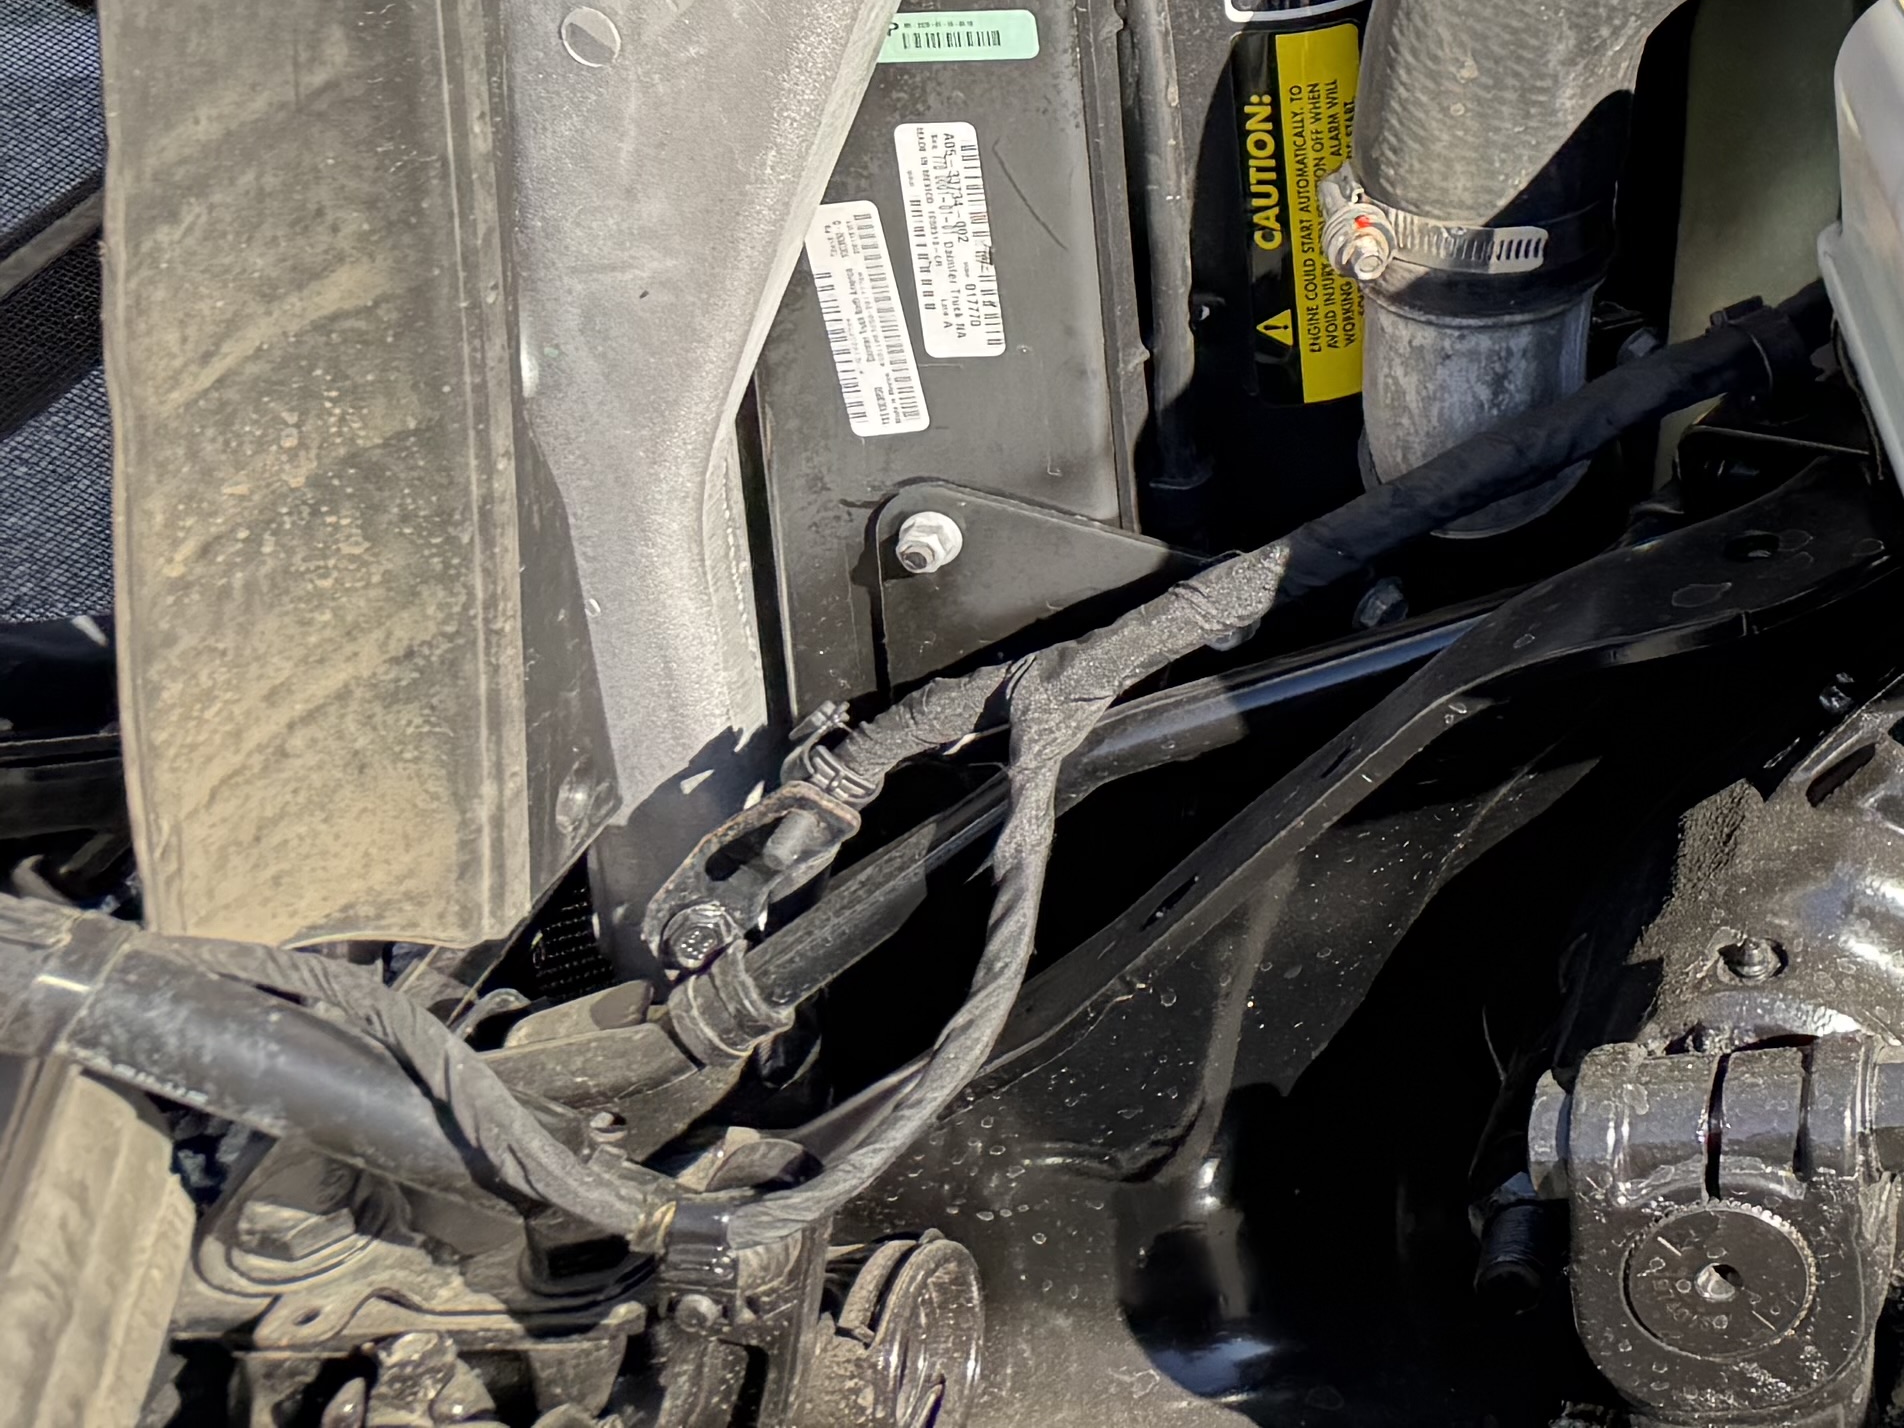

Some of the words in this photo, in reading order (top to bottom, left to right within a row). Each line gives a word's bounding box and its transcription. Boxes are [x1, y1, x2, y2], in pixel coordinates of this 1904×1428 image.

[1289, 84, 1303, 102] TO
[1308, 82, 1322, 119] WHEN
[1325, 79, 1340, 114] WILL
[1311, 123, 1326, 150] OFF
[1328, 115, 1343, 158] ALARM
[1244, 93, 1283, 251] CAUTION:
[1301, 213, 1315, 254] START
[1304, 255, 1319, 303] COULD
[951, 288, 964, 319] Truck
[964, 282, 982, 328] 017770
[1341, 279, 1358, 348] WORKING
[1307, 304, 1322, 354] ENGINE
[1325, 308, 1340, 349] AVOID
